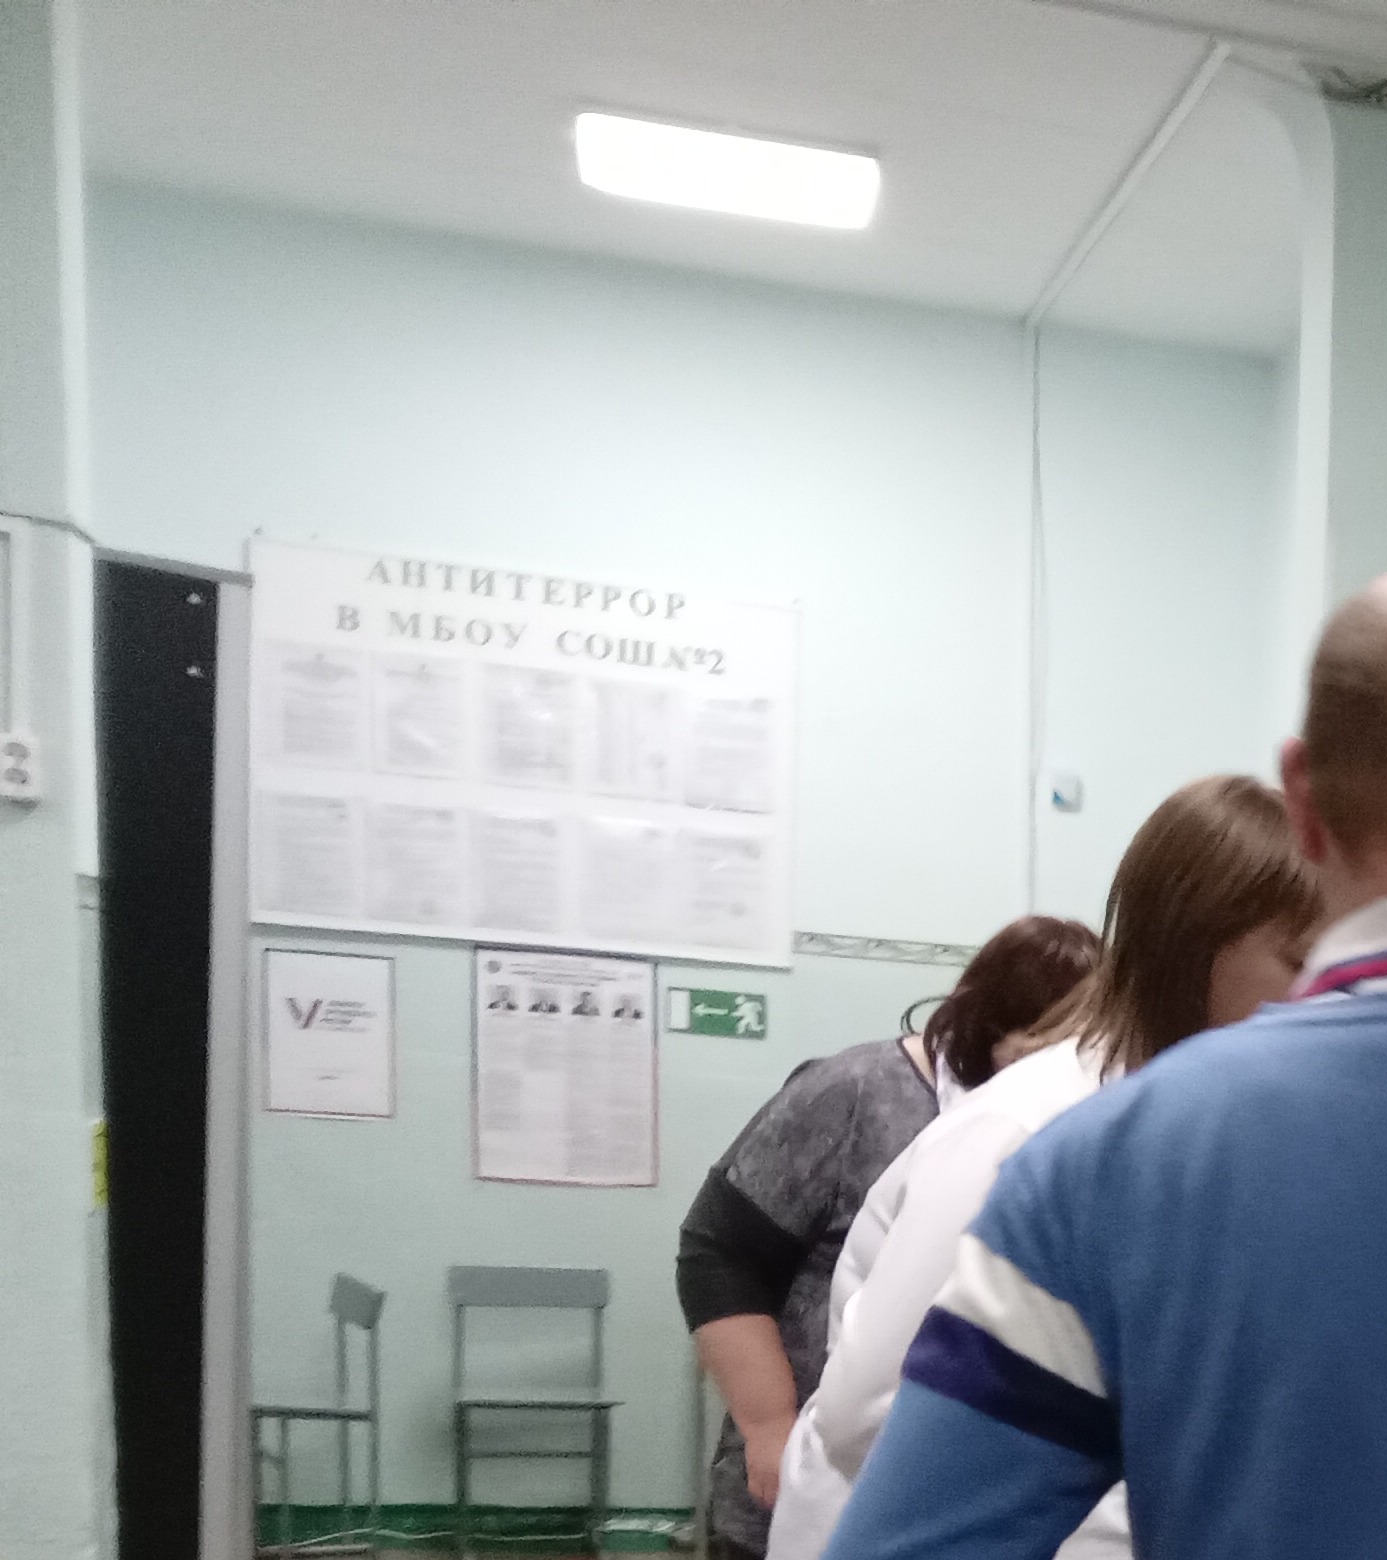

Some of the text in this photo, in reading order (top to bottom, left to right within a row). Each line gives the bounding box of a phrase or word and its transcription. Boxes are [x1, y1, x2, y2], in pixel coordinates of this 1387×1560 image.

[365, 558, 687, 620] АНТИТЕРРОР
[336, 603, 361, 633] В
[387, 610, 528, 649] МБОУ
